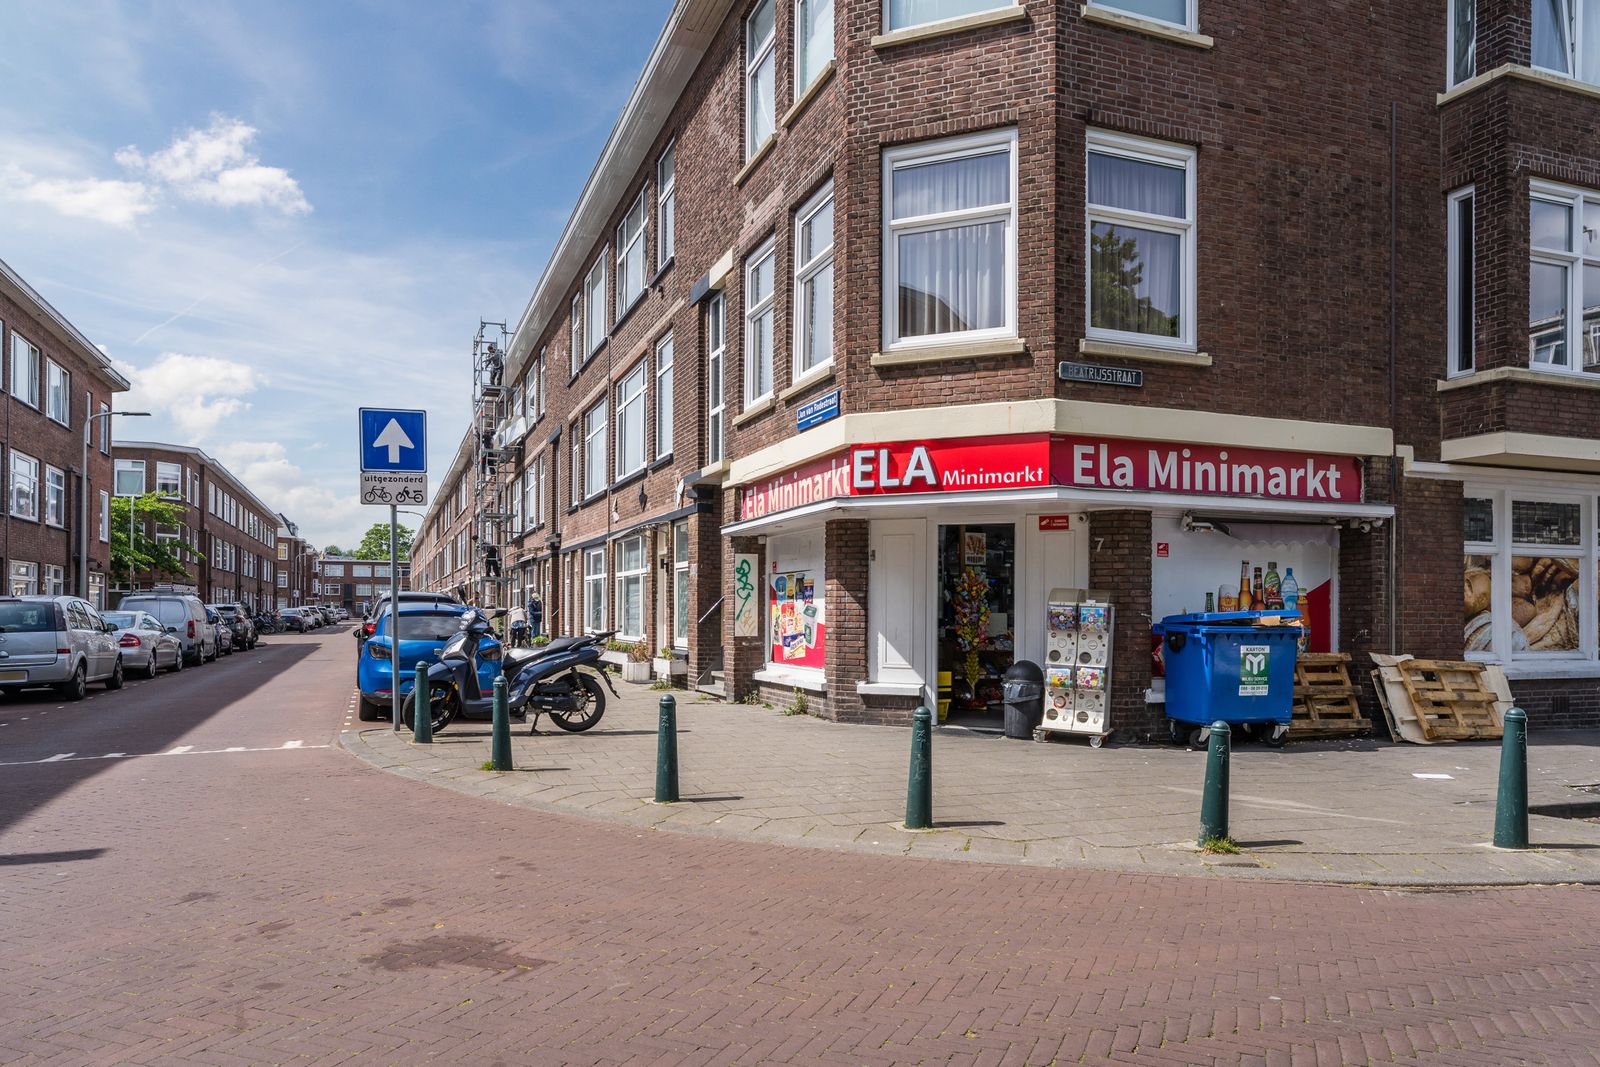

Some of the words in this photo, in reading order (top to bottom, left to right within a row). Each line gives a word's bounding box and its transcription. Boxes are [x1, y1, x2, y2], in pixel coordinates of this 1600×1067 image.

[1068, 365, 1137, 383] BEATRIJSSTRAAT
[806, 406, 814, 415] van
[853, 445, 937, 488] ELA
[942, 465, 1044, 487] Minimarkt
[1073, 443, 1134, 487] Ela
[1148, 448, 1342, 499] Minimarkt
[364, 475, 423, 484] uitgezonderd
[746, 486, 765, 519] Ela
[768, 458, 849, 514] Minimarkt
[1094, 537, 1105, 552] 7
